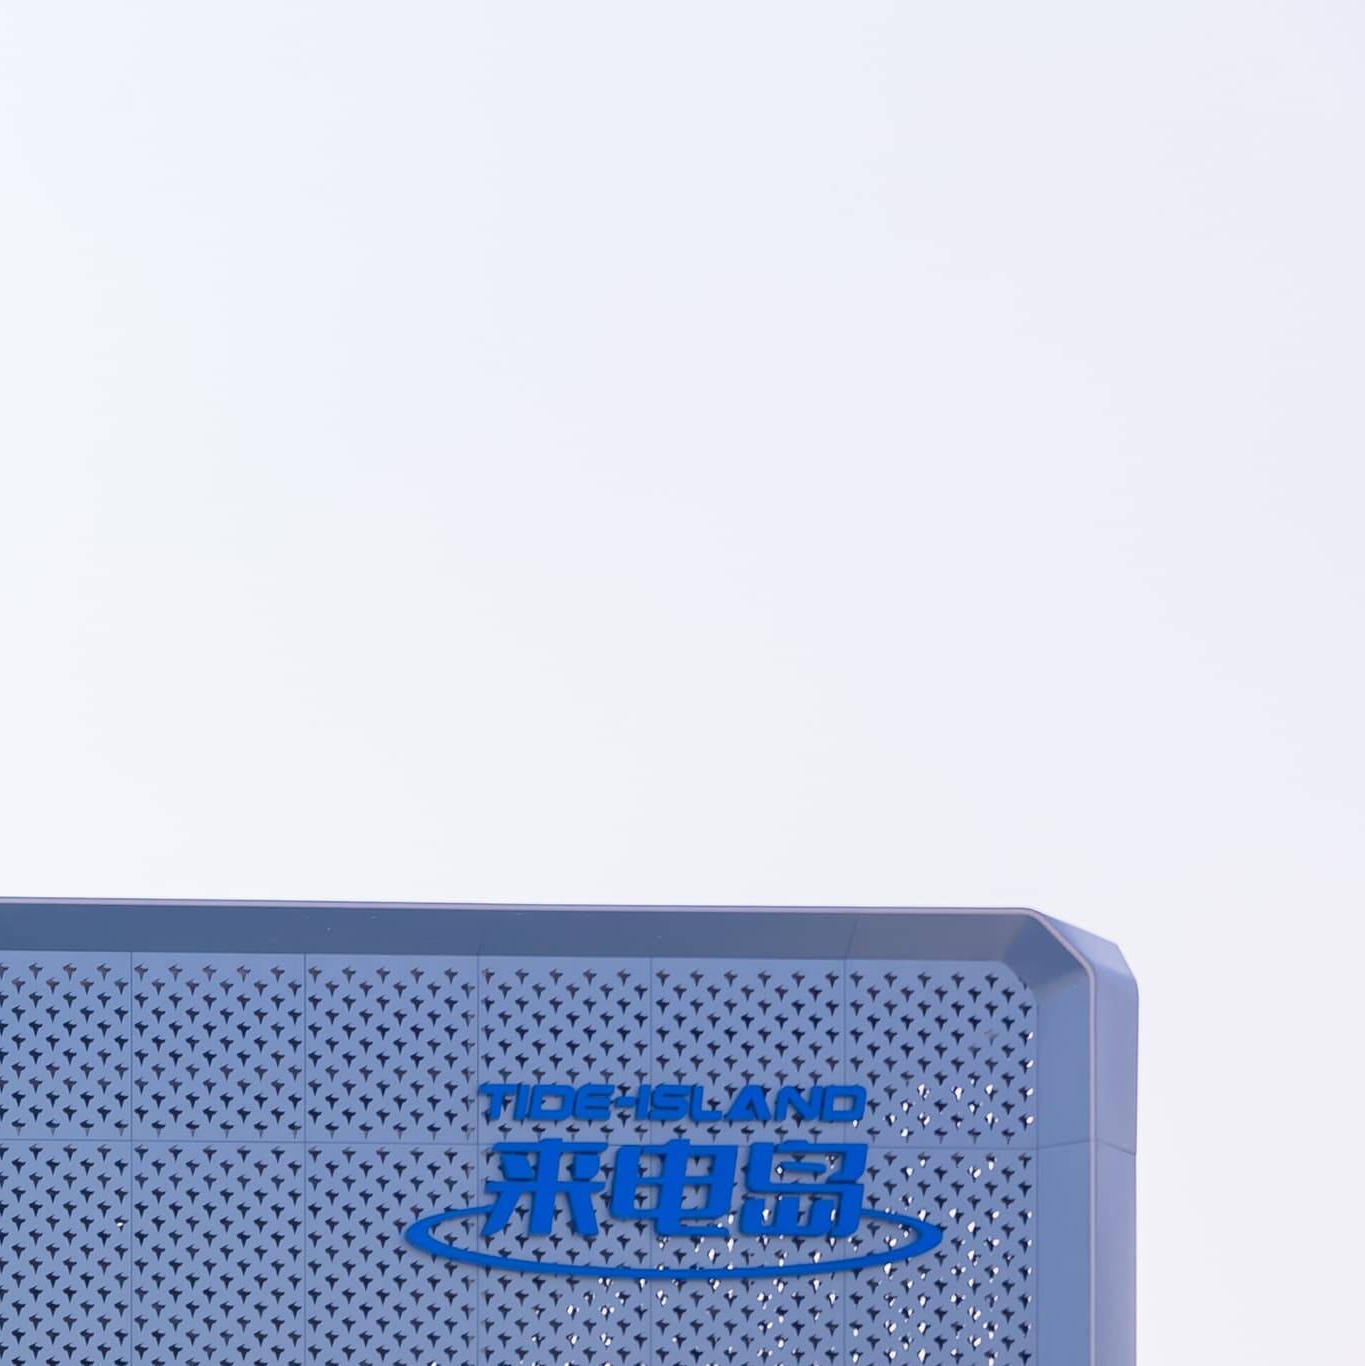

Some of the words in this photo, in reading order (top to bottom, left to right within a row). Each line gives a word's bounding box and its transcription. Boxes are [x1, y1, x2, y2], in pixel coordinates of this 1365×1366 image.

[478, 1082, 867, 1123] TIDE-ISLAND
[480, 1138, 868, 1238] 来电岛
